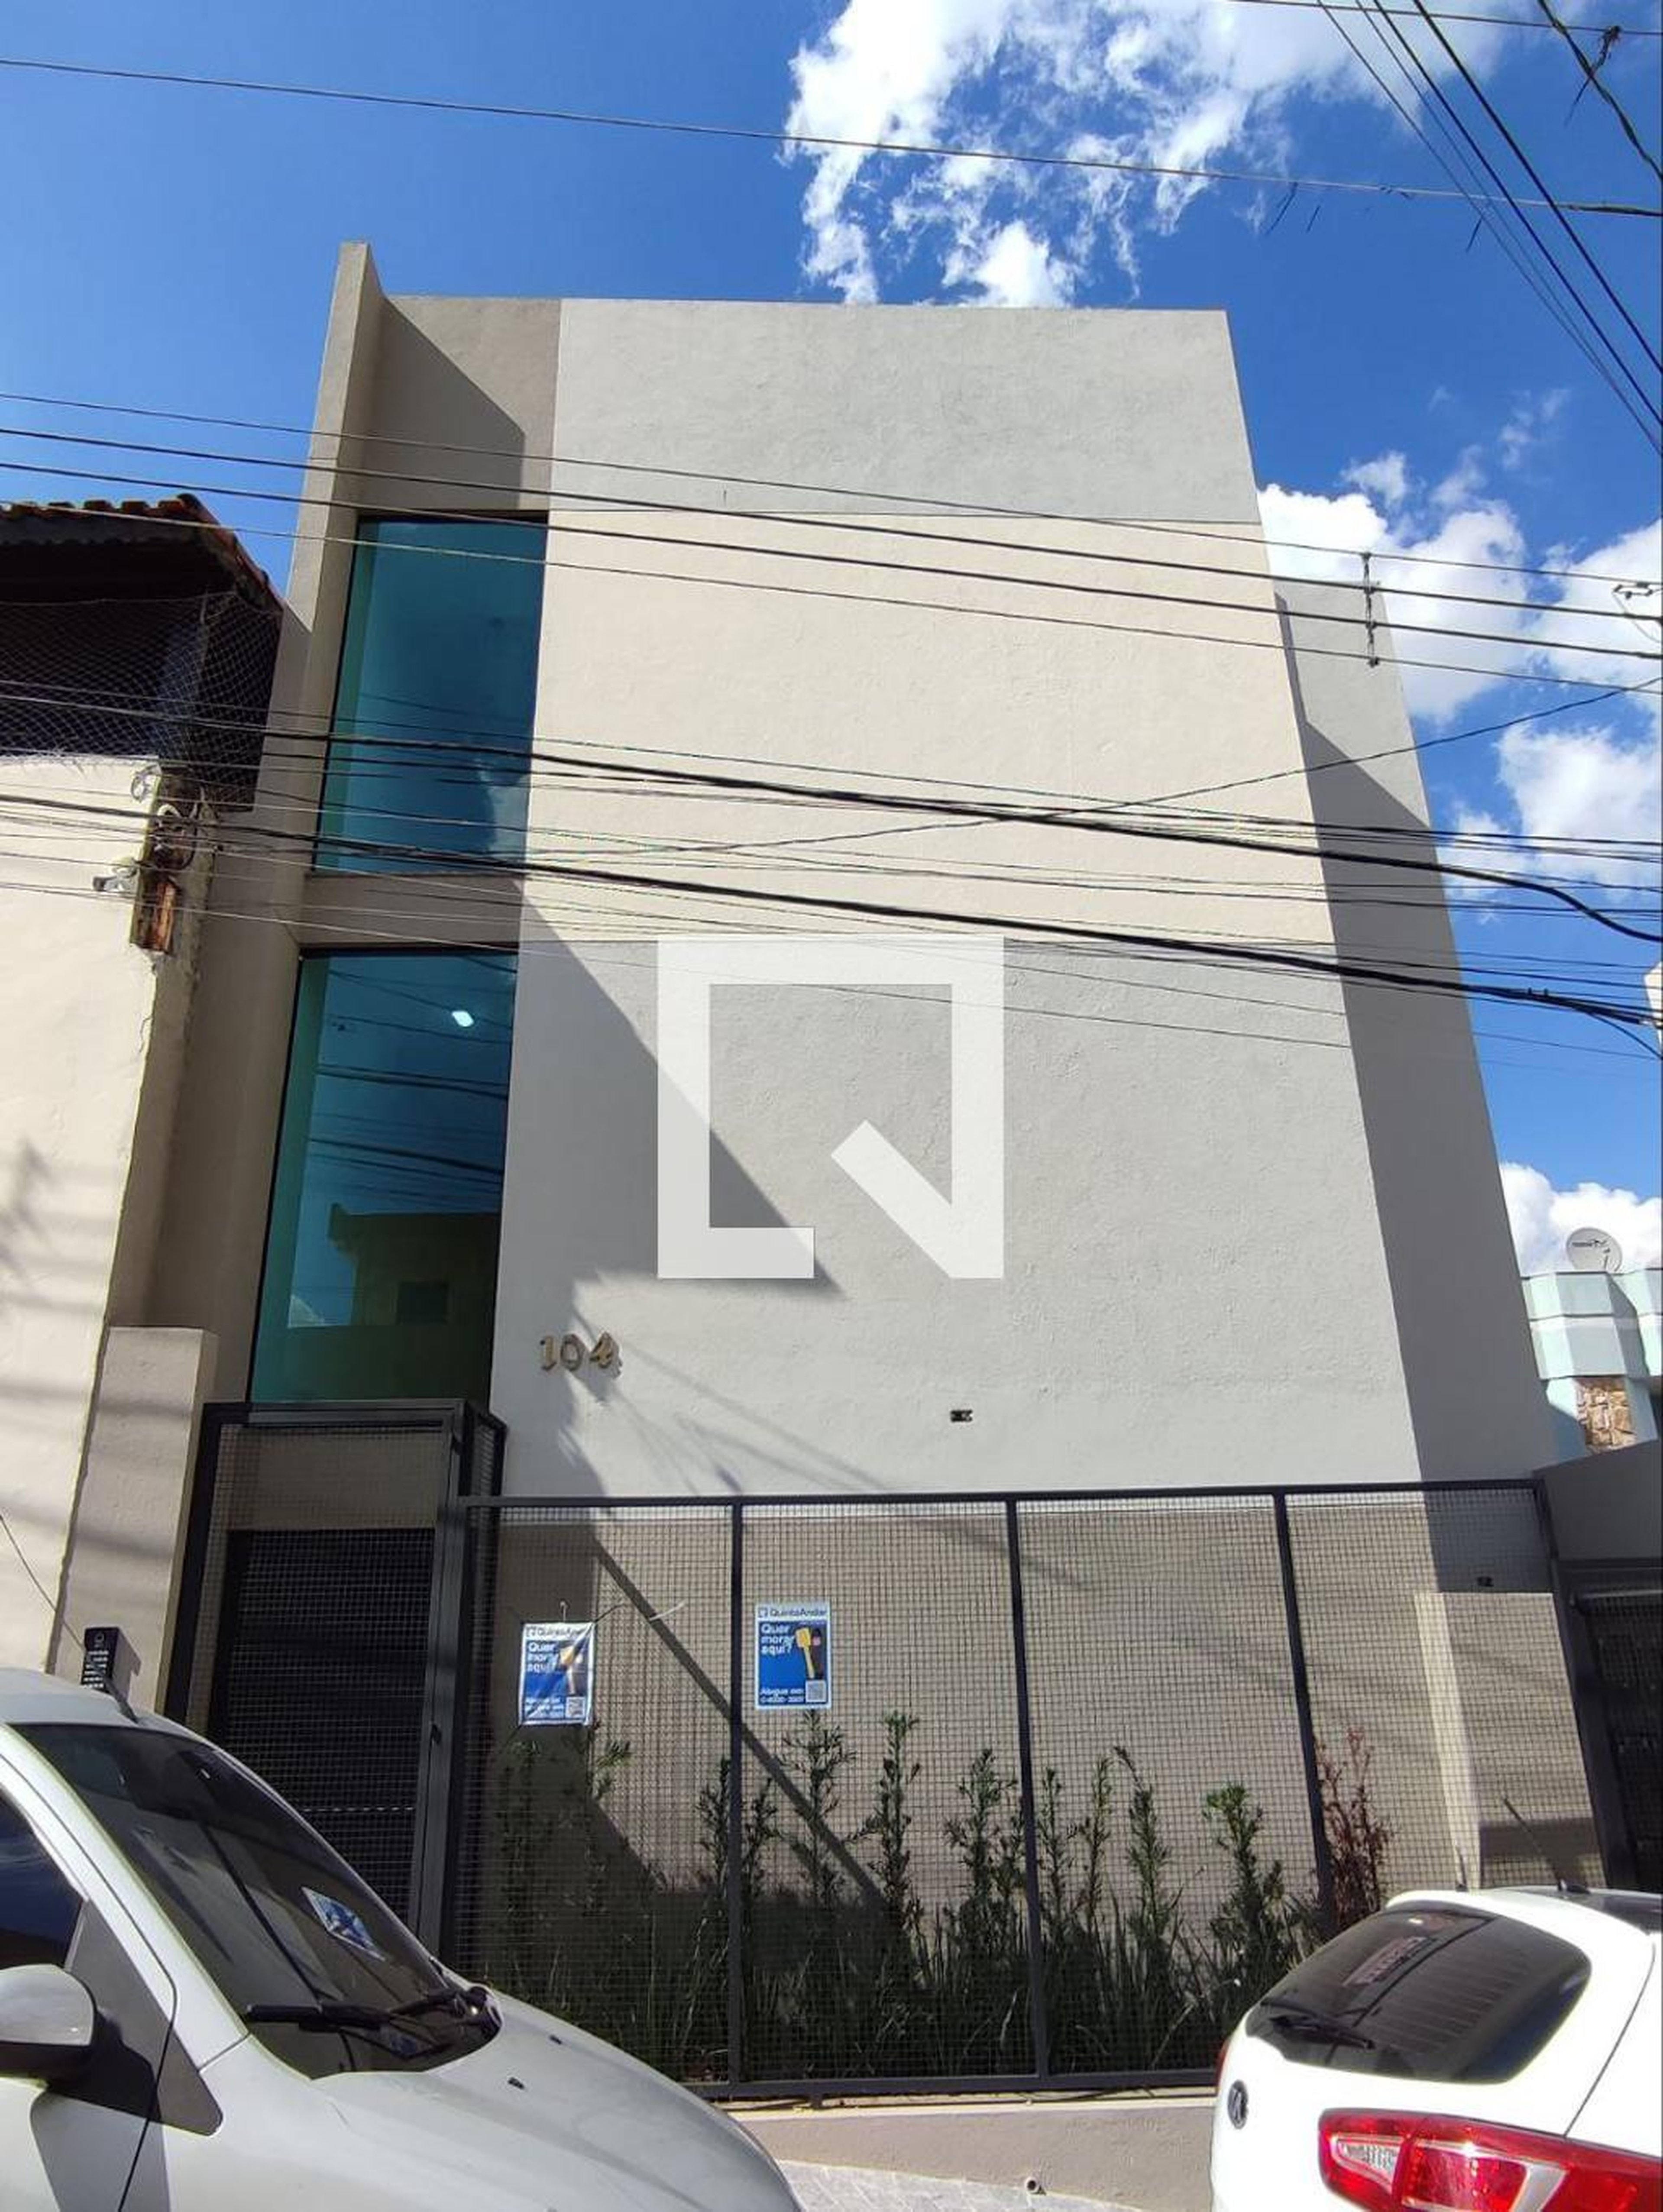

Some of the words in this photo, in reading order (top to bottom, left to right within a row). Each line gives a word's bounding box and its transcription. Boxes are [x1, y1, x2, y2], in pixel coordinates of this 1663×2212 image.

[540, 1331, 619, 1372] 104
[761, 1623, 790, 1634] Quer
[761, 1636, 795, 1644] morar
[529, 1643, 557, 1652] Quer
[761, 1645, 792, 1656] aqui?
